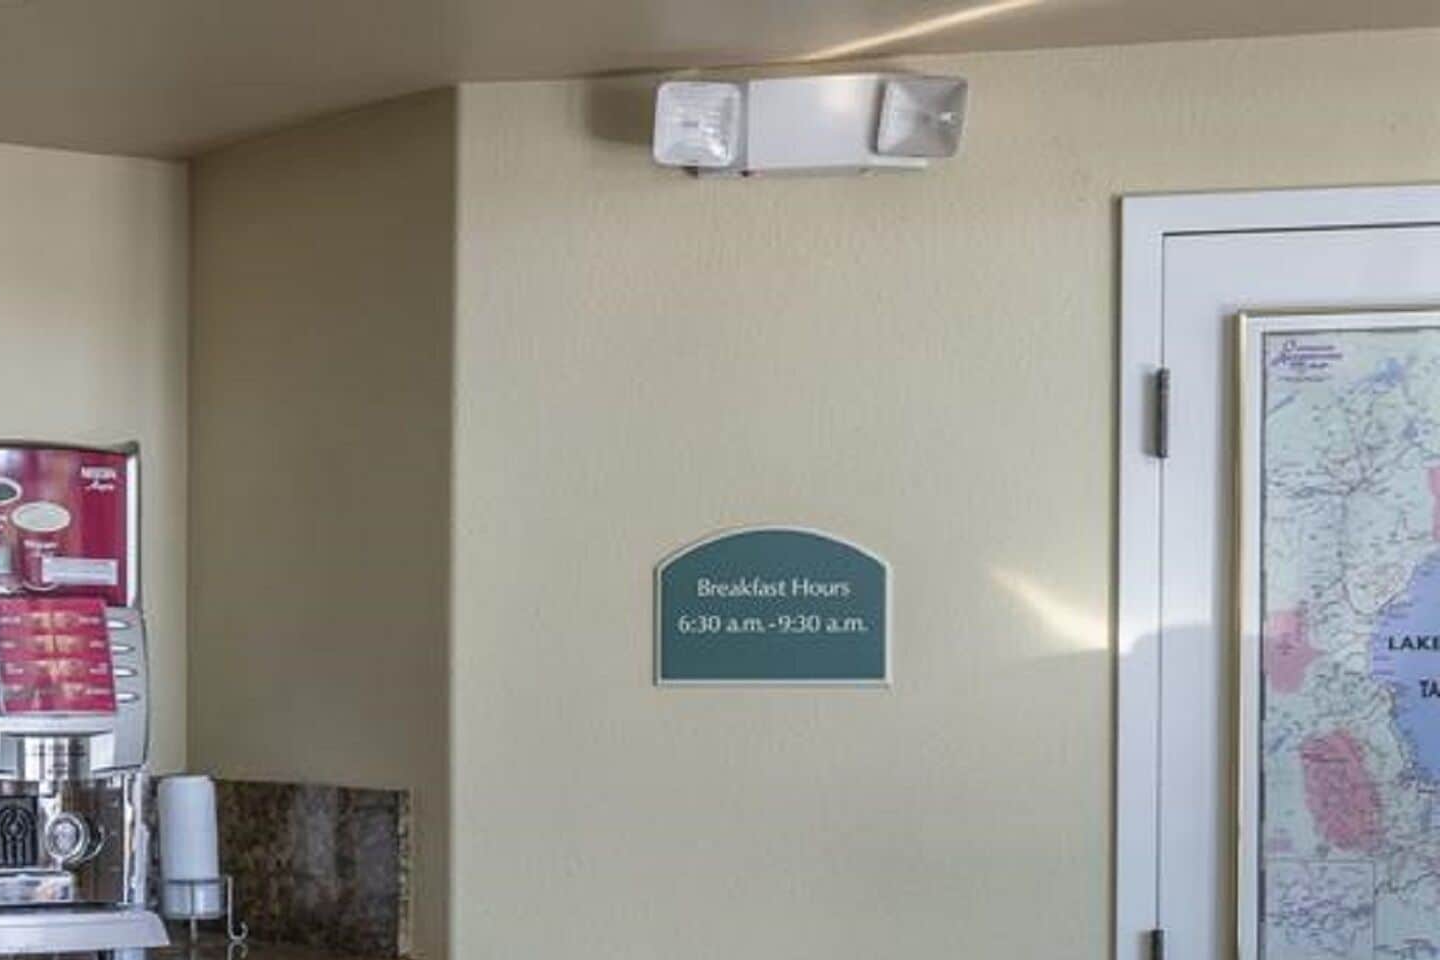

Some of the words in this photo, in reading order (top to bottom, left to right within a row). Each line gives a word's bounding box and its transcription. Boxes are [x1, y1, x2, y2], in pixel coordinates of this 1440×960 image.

[697, 576, 785, 597] Breakfast
[791, 578, 851, 597] Hours
[678, 615, 721, 634] 6:30
[826, 617, 869, 633] a.m.
